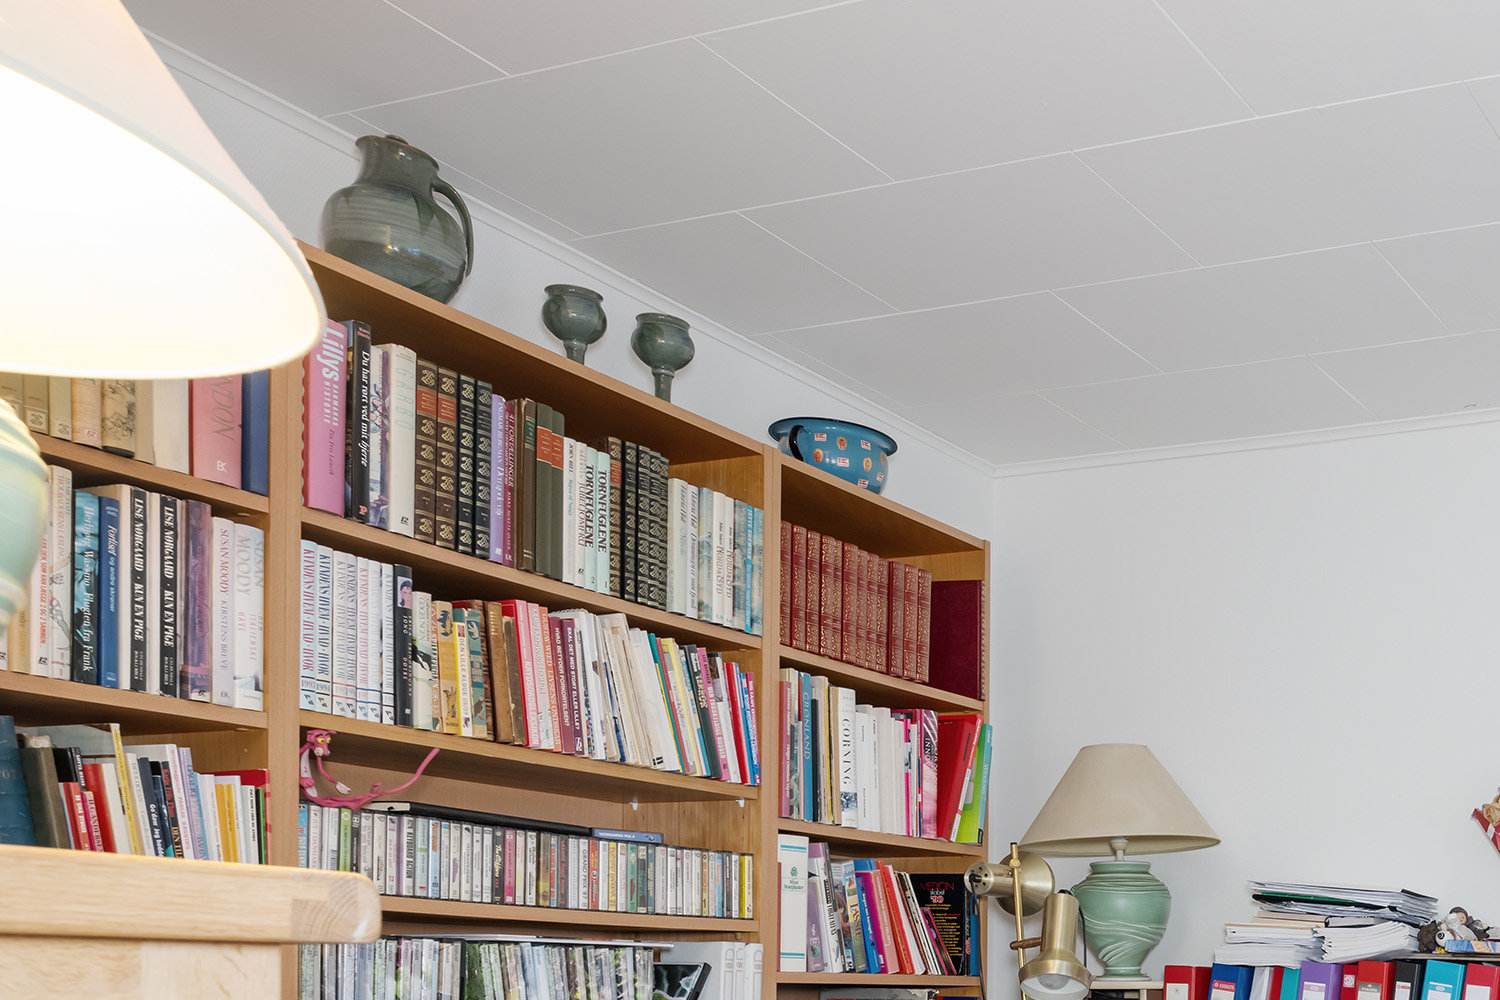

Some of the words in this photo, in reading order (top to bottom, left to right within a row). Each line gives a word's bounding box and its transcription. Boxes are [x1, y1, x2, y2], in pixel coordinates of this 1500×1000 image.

[317, 327, 343, 381] Lillys
[362, 351, 369, 366] Du
[395, 368, 414, 430] GARBO
[509, 414, 513, 423] 41
[358, 441, 369, 467] hjerte
[134, 498, 144, 519] LISE
[164, 507, 174, 527] LISE
[585, 465, 593, 548] TORNFUGLENE
[598, 470, 607, 552] TORNFUGLENE
[82, 506, 95, 547] Herbjørg
[107, 525, 117, 555] Forliset
[220, 529, 230, 559] SUSAN
[83, 550, 93, 586] Wassmo
[220, 560, 230, 595] MOODY
[237, 535, 251, 597] MOODY
[303, 549, 314, 589] KVINDENS
[318, 554, 331, 594] KVINDENS
[134, 583, 144, 601] KUN
[347, 563, 355, 602] KVINDENS
[359, 567, 368, 607] KVINDENS
[81, 592, 93, 626] Flugten
[133, 602, 144, 616] EN
[164, 590, 174, 607] KUN
[303, 591, 314, 619] HVEM
[318, 595, 330, 621] HVEM
[134, 619, 144, 641] PIGE
[164, 608, 174, 623] EN
[83, 629, 94, 642] fra
[164, 625, 174, 647] PIGE
[303, 620, 314, 642] HVAD
[318, 625, 330, 647] HVAD
[83, 644, 94, 671] Frank
[220, 643, 228, 670] BREVE
[303, 649, 314, 671] HVOR
[318, 652, 330, 675] HVOR
[542, 613, 550, 643] GUSTAV
[546, 670, 556, 704] LIVSENS
[551, 705, 560, 745] ONDSKAB
[556, 646, 564, 674] BETYDER
[560, 675, 569, 726] FORKORTELSEN?
[696, 675, 708, 709] TERROR
[524, 661, 538, 745] KRYDSORDSLEKSIKON
[803, 692, 811, 760] GRØNLAND
[842, 718, 852, 784] CORNING
